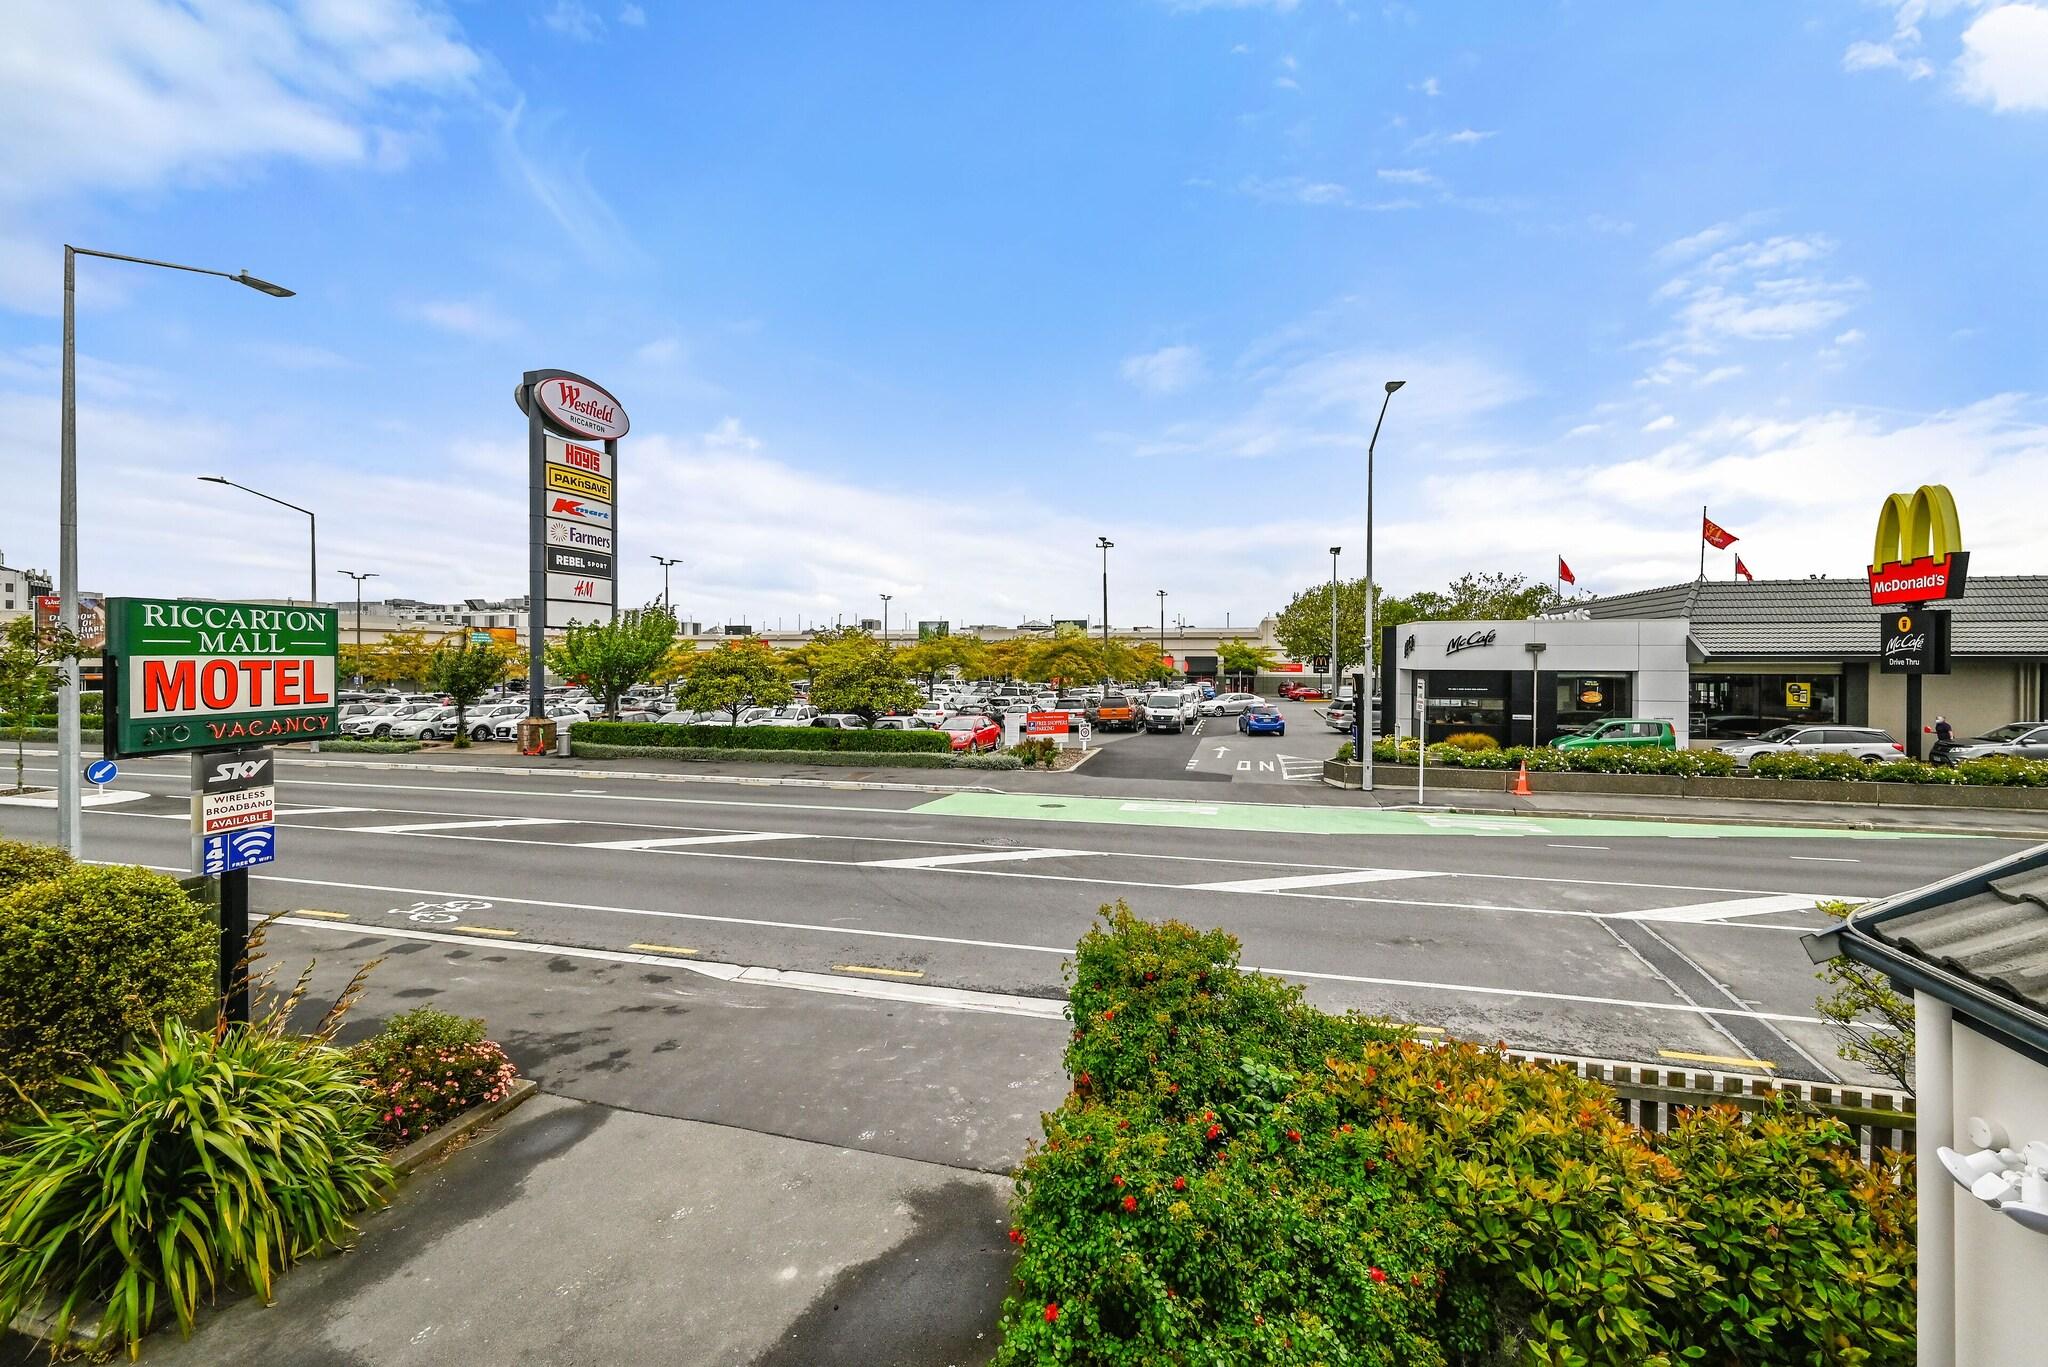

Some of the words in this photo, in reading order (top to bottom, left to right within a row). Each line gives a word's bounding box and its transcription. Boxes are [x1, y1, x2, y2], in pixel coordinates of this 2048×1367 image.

[558, 382, 615, 423] Westfield
[569, 415, 606, 433] RICCARTON
[565, 444, 600, 472] HOYTS
[552, 498, 609, 520] Kmart
[569, 526, 611, 549] Farmers
[556, 554, 585, 569] REBEL
[587, 560, 608, 569] SPORT
[574, 579, 594, 598] H&M
[1873, 573, 1946, 594] McDonald's
[142, 604, 326, 632] RICCARTON
[198, 631, 286, 653] MALL
[1885, 632, 1924, 657] McCafé
[1889, 657, 1905, 667] Drive
[1905, 657, 1920, 667] Thru
[143, 659, 329, 713] MOTEL
[143, 723, 190, 746] NO
[207, 716, 329, 739] VACANCY
[208, 759, 270, 783] SKY
[206, 799, 273, 816] BROADBAND
[214, 790, 265, 804] WIRELESS
[211, 812, 269, 829] AVAILABLE
[231, 860, 249, 868] FREE
